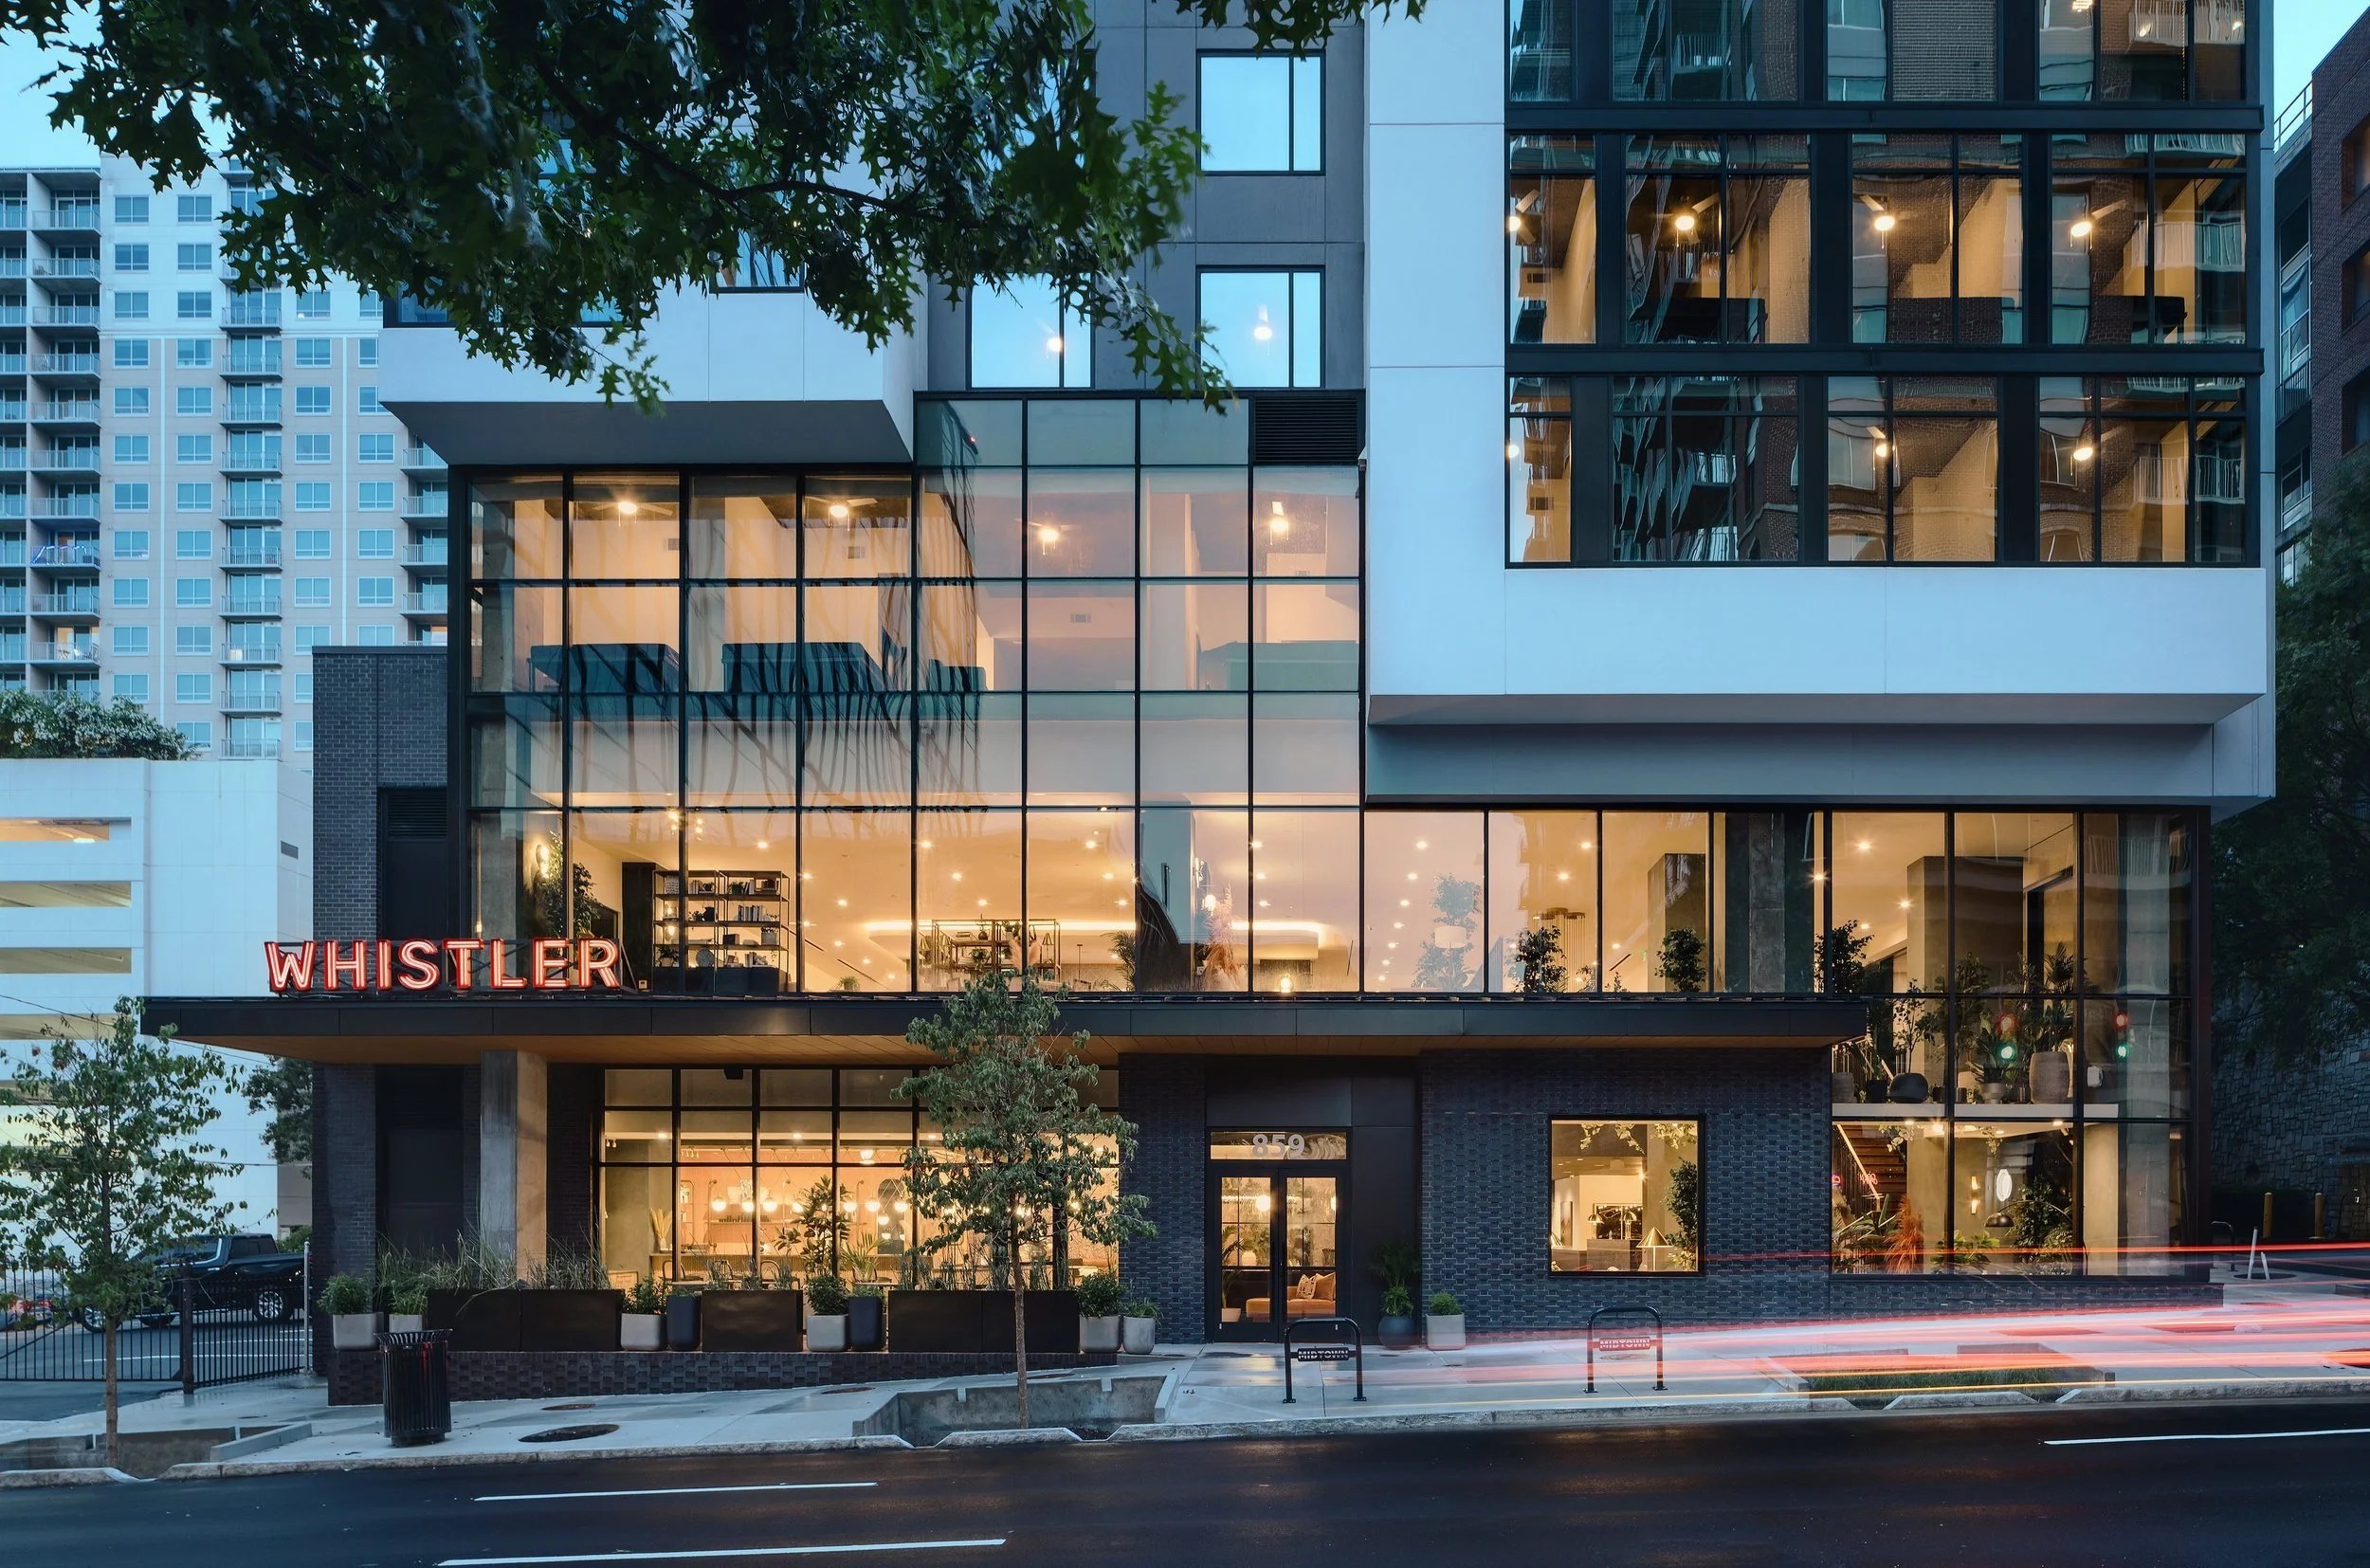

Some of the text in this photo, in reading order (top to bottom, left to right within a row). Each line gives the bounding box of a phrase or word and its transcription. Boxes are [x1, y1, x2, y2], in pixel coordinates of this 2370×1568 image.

[264, 938, 622, 991] WHISTLER
[1251, 1133, 1305, 1159] 859
[1600, 1340, 1650, 1349] MIDTOWN
[1298, 1350, 1349, 1359] MIDTOWN
